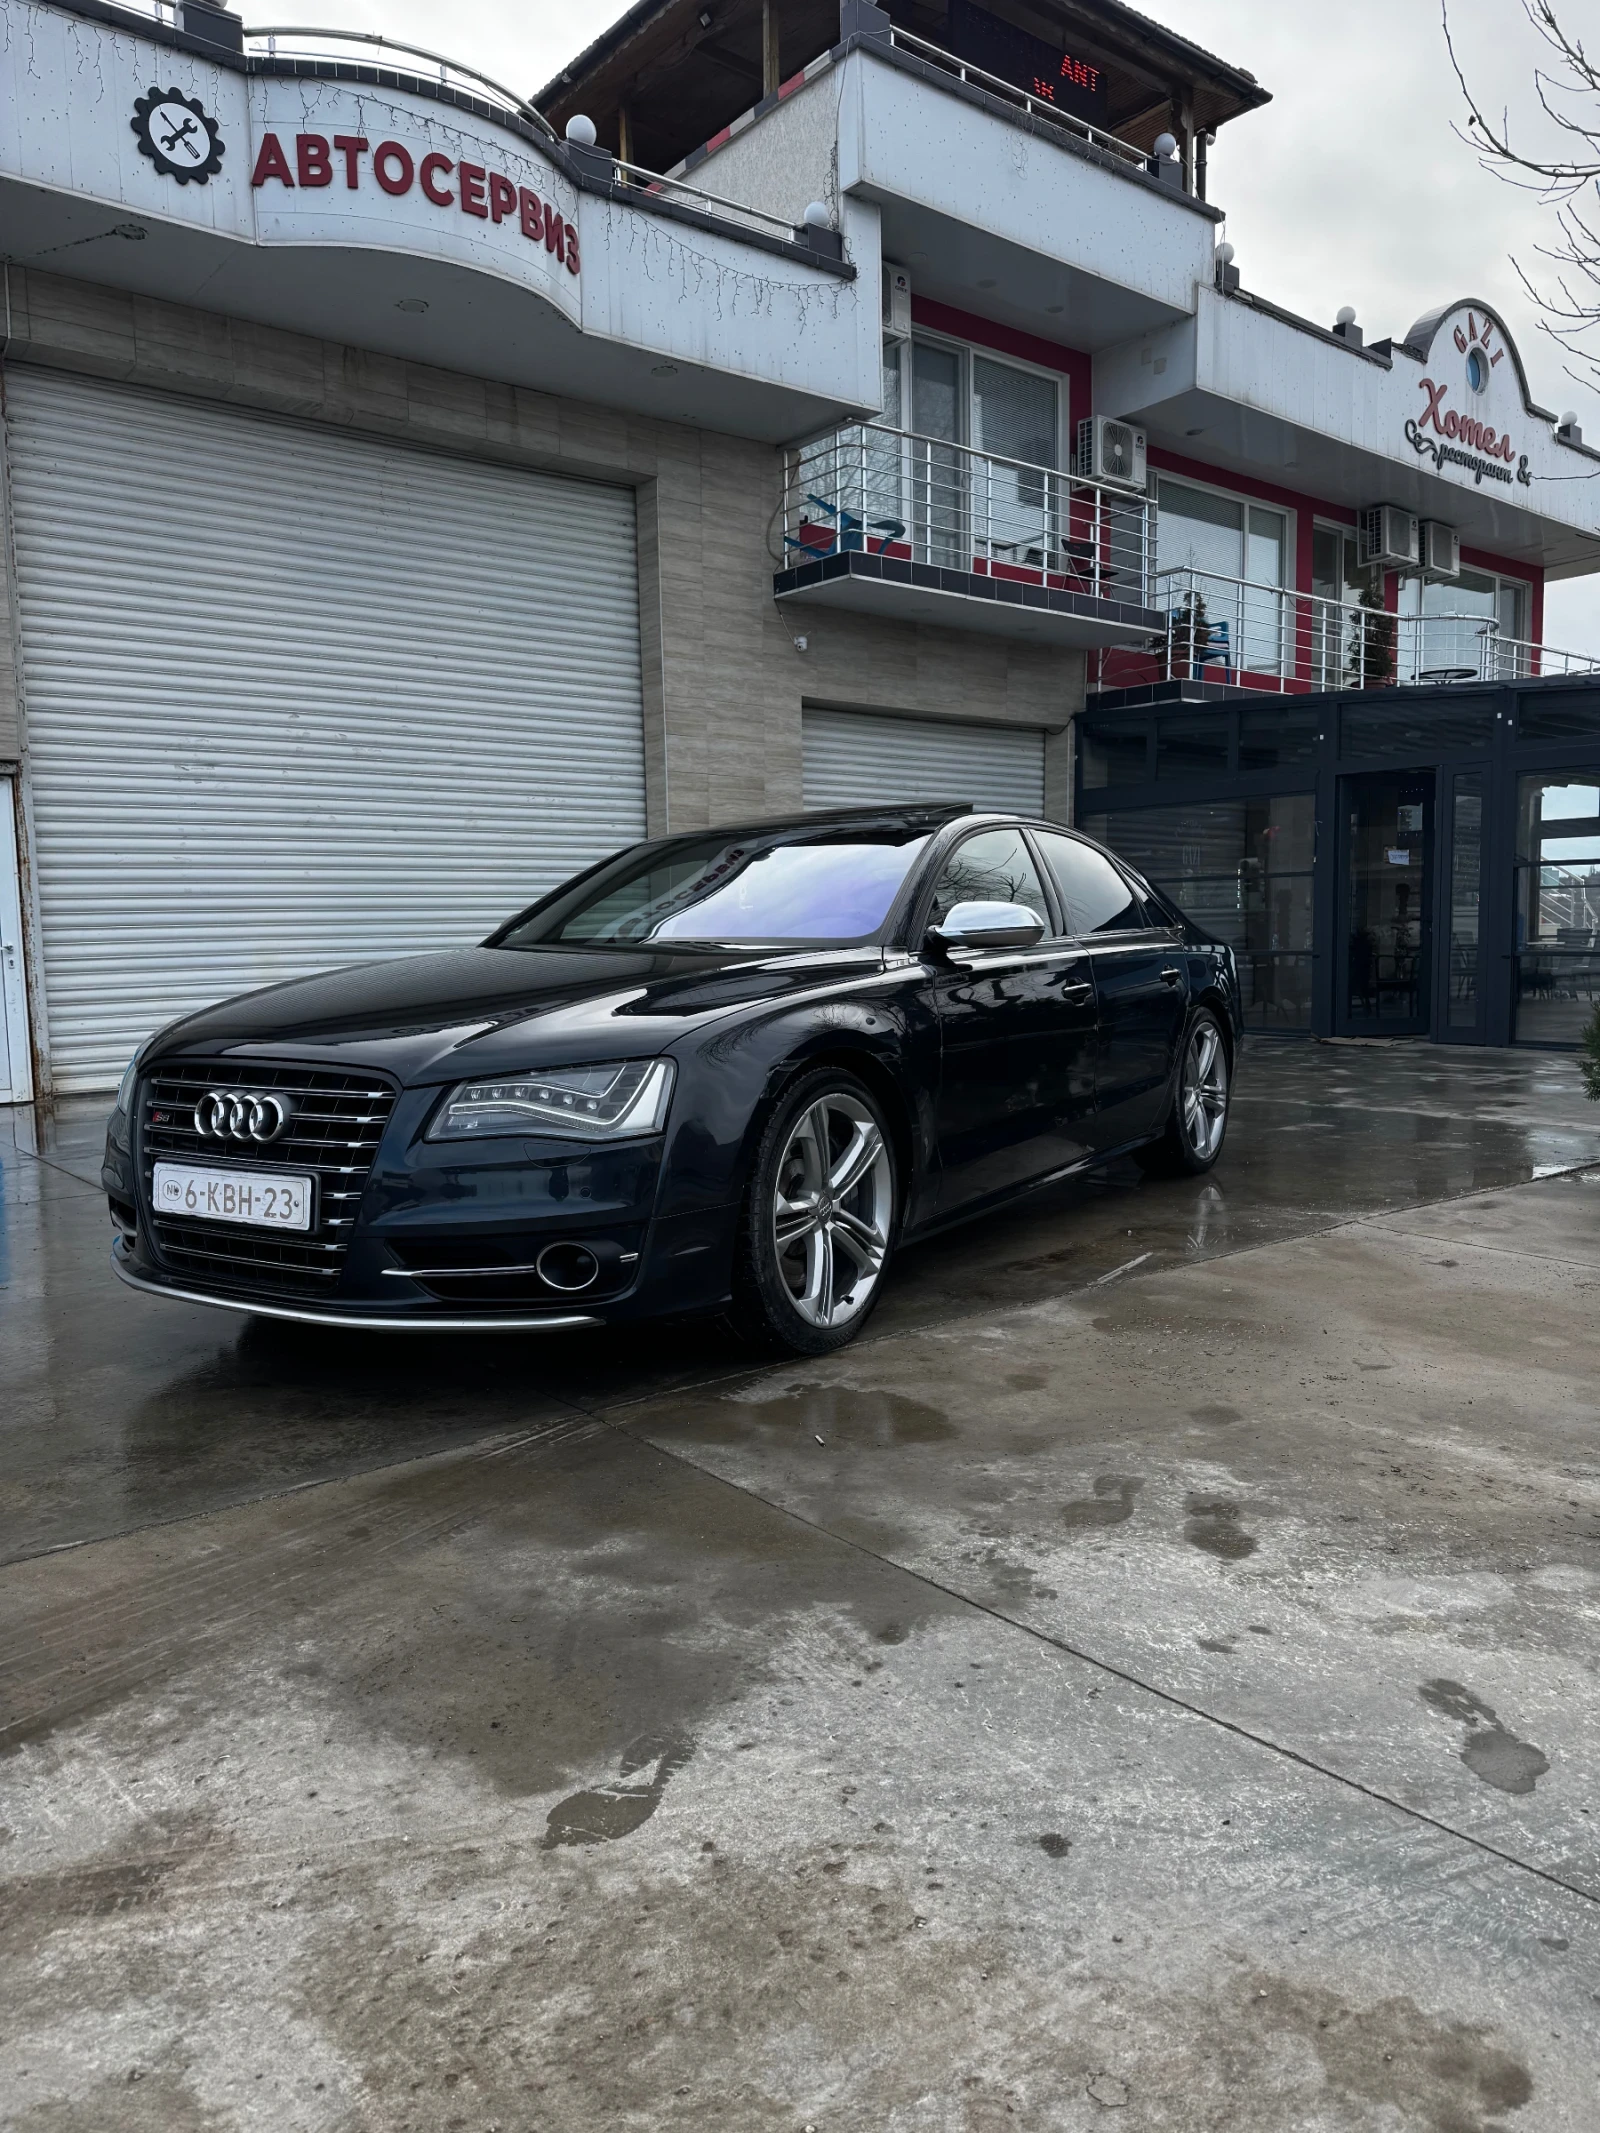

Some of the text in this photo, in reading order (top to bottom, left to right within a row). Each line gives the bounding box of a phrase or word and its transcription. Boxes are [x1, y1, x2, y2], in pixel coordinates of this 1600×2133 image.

[251, 133, 581, 275] АВТОСЕРВИЗ
[1453, 312, 1504, 368] GAZI
[1419, 378, 1516, 462] Хотел
[1436, 443, 1514, 485] ресторант
[185, 1179, 293, 1220] 6-KBH-23
